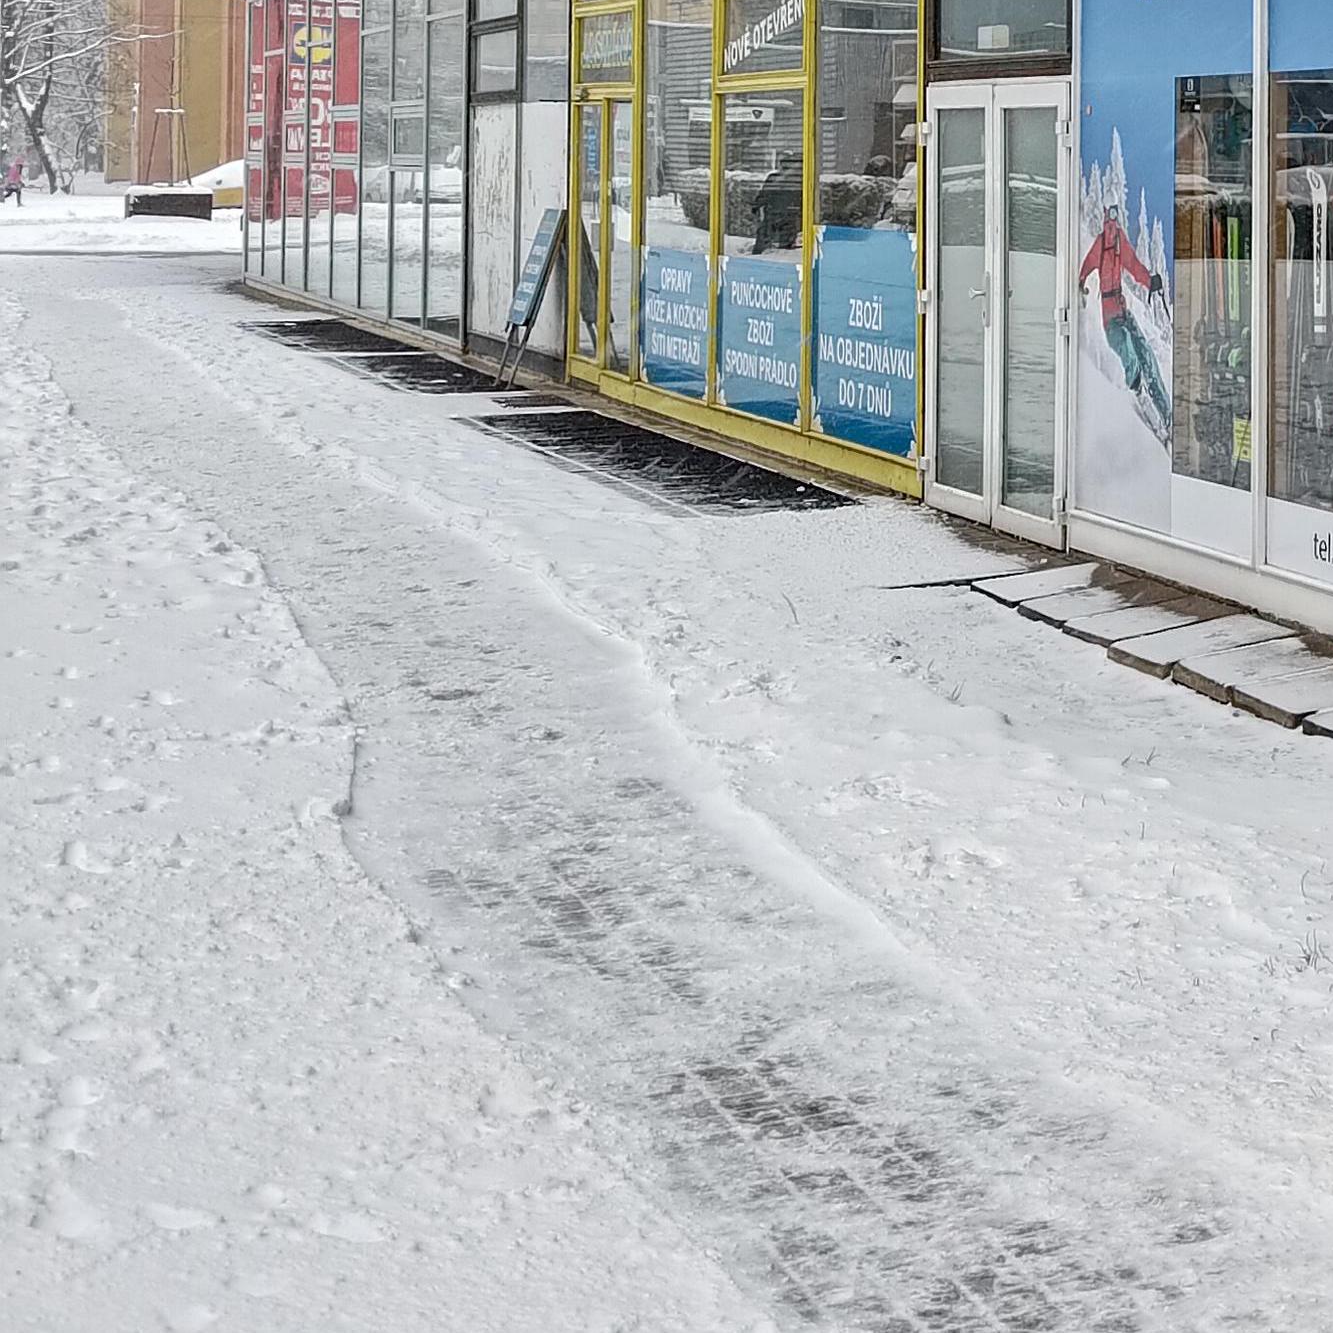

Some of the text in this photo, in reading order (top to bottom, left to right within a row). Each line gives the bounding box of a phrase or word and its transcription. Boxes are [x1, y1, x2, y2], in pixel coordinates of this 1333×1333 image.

[661, 267, 692, 294] OPRAVY
[731, 277, 793, 314] PUNČOCHOVÉ
[747, 315, 774, 346] ZBOŽÍ
[849, 295, 882, 331] ZBOŽÍ
[725, 349, 797, 389] SPODNÍ PRÁDLO
[820, 333, 915, 380] NA OBJEDNÁVKU
[839, 377, 892, 418] DO 7 DNŮ
